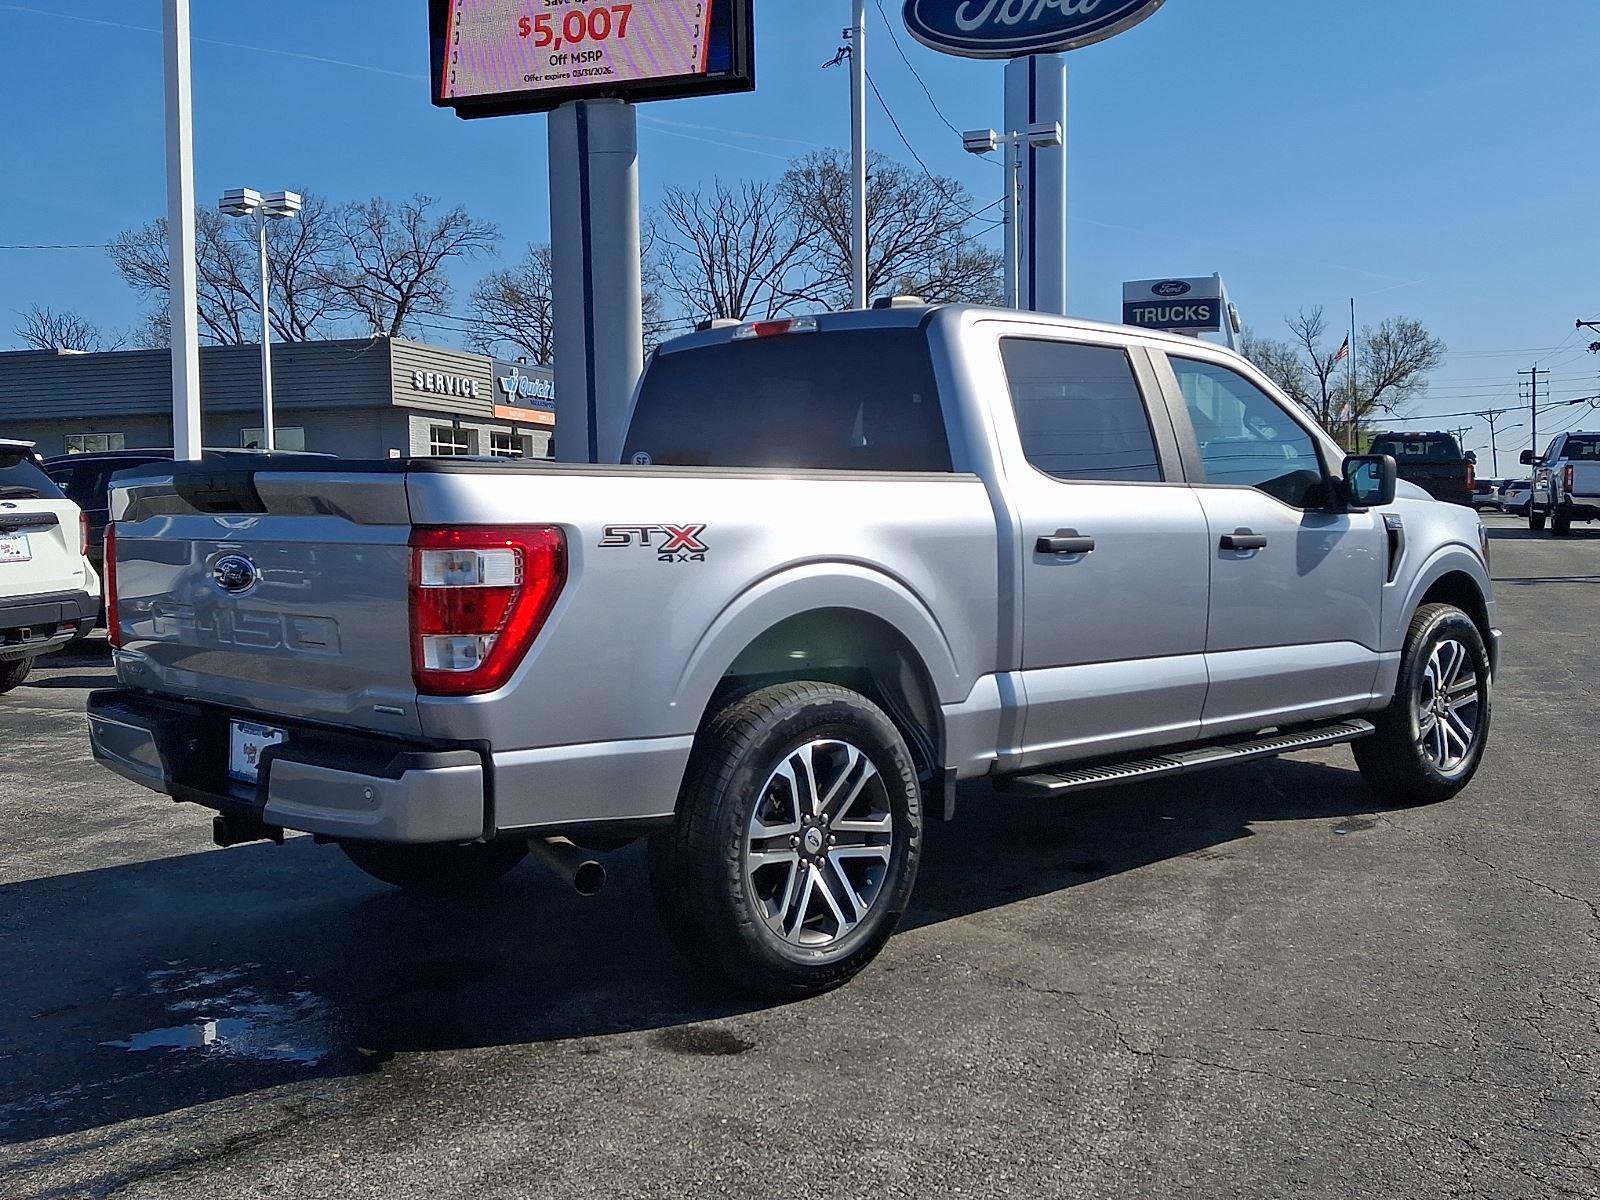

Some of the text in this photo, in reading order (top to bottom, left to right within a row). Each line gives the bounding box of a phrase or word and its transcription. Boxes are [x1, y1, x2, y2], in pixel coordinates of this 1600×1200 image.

[518, 4, 632, 51] $5,007
[549, 50, 603, 66] Off MSRP
[523, 73, 543, 83] Offer
[544, 71, 571, 81] expires
[1159, 283, 1183, 293] Ford
[1132, 305, 1211, 323] TRUCKS
[414, 370, 479, 396] SERVICE
[518, 375, 551, 399] Quick
[598, 524, 709, 554] STX
[657, 553, 706, 563] 4x4
